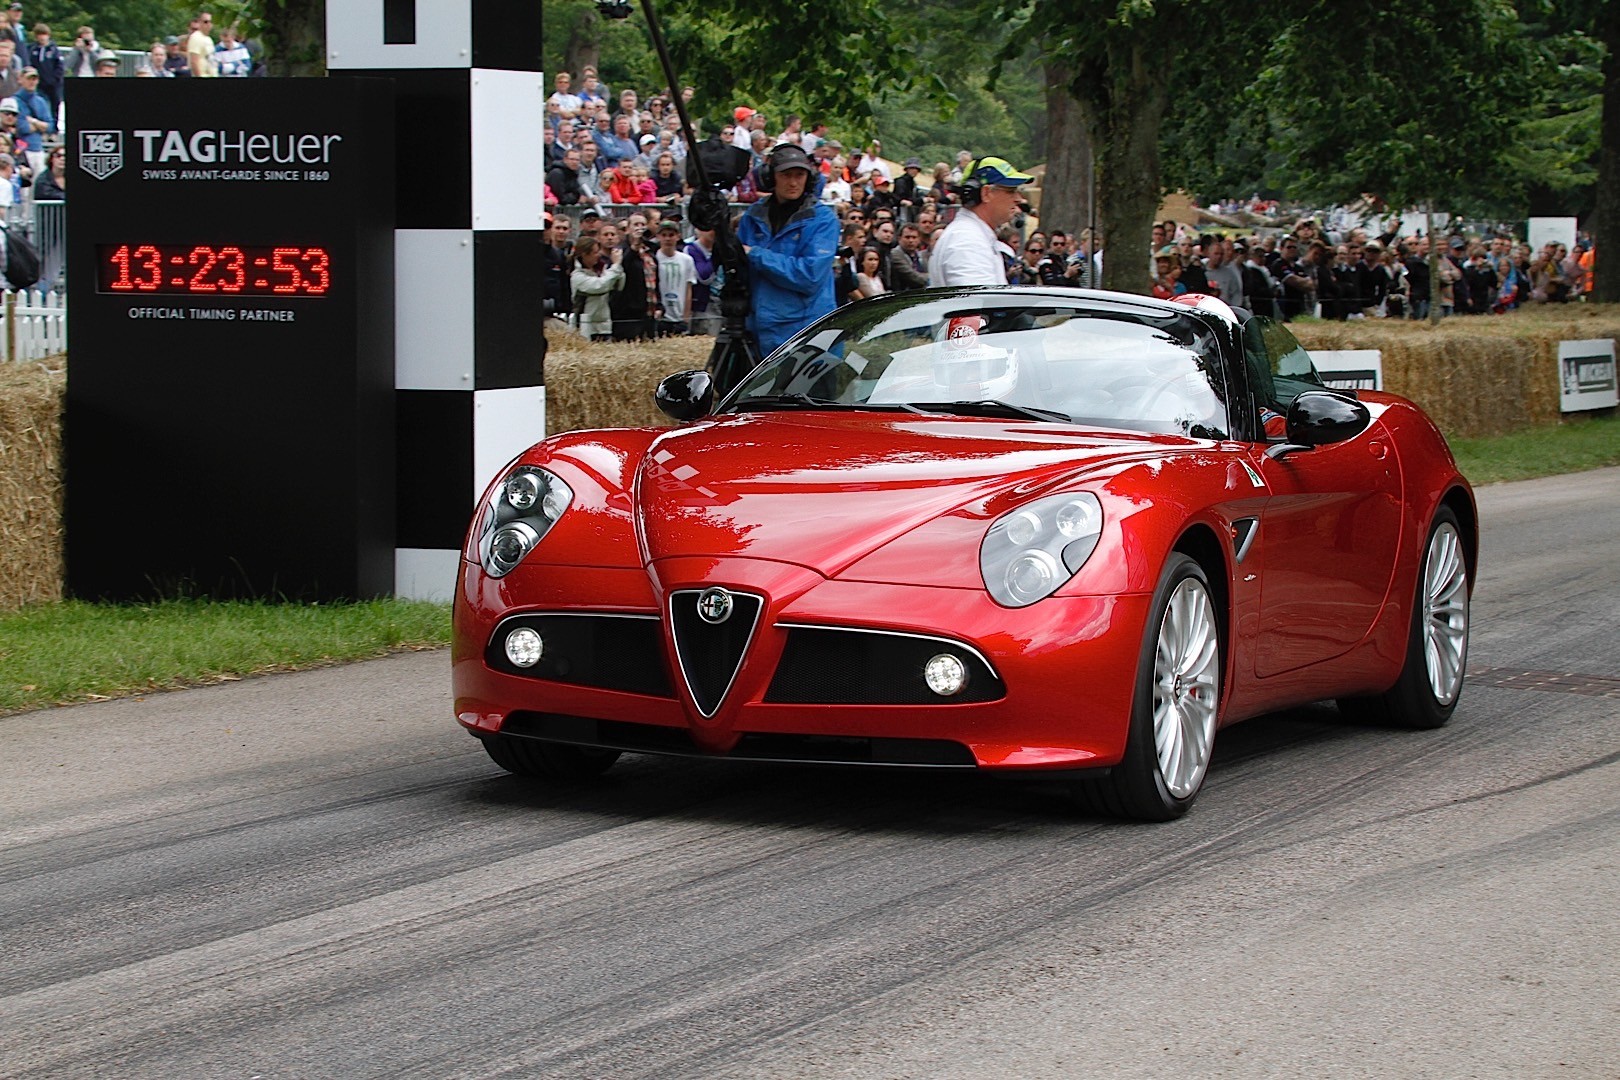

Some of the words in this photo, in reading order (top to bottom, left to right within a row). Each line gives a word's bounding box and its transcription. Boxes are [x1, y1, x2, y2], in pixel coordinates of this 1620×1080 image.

[86, 134, 117, 152] TAG
[83, 156, 120, 175] HEUER
[142, 169, 177, 180] SWISS
[180, 169, 261, 181] AVANT-GARDE
[264, 170, 300, 181] SINCE
[303, 170, 330, 181] 1860
[128, 307, 186, 320] OFFICIAL
[189, 308, 236, 321] TIMING
[239, 309, 295, 322] PARTNER
